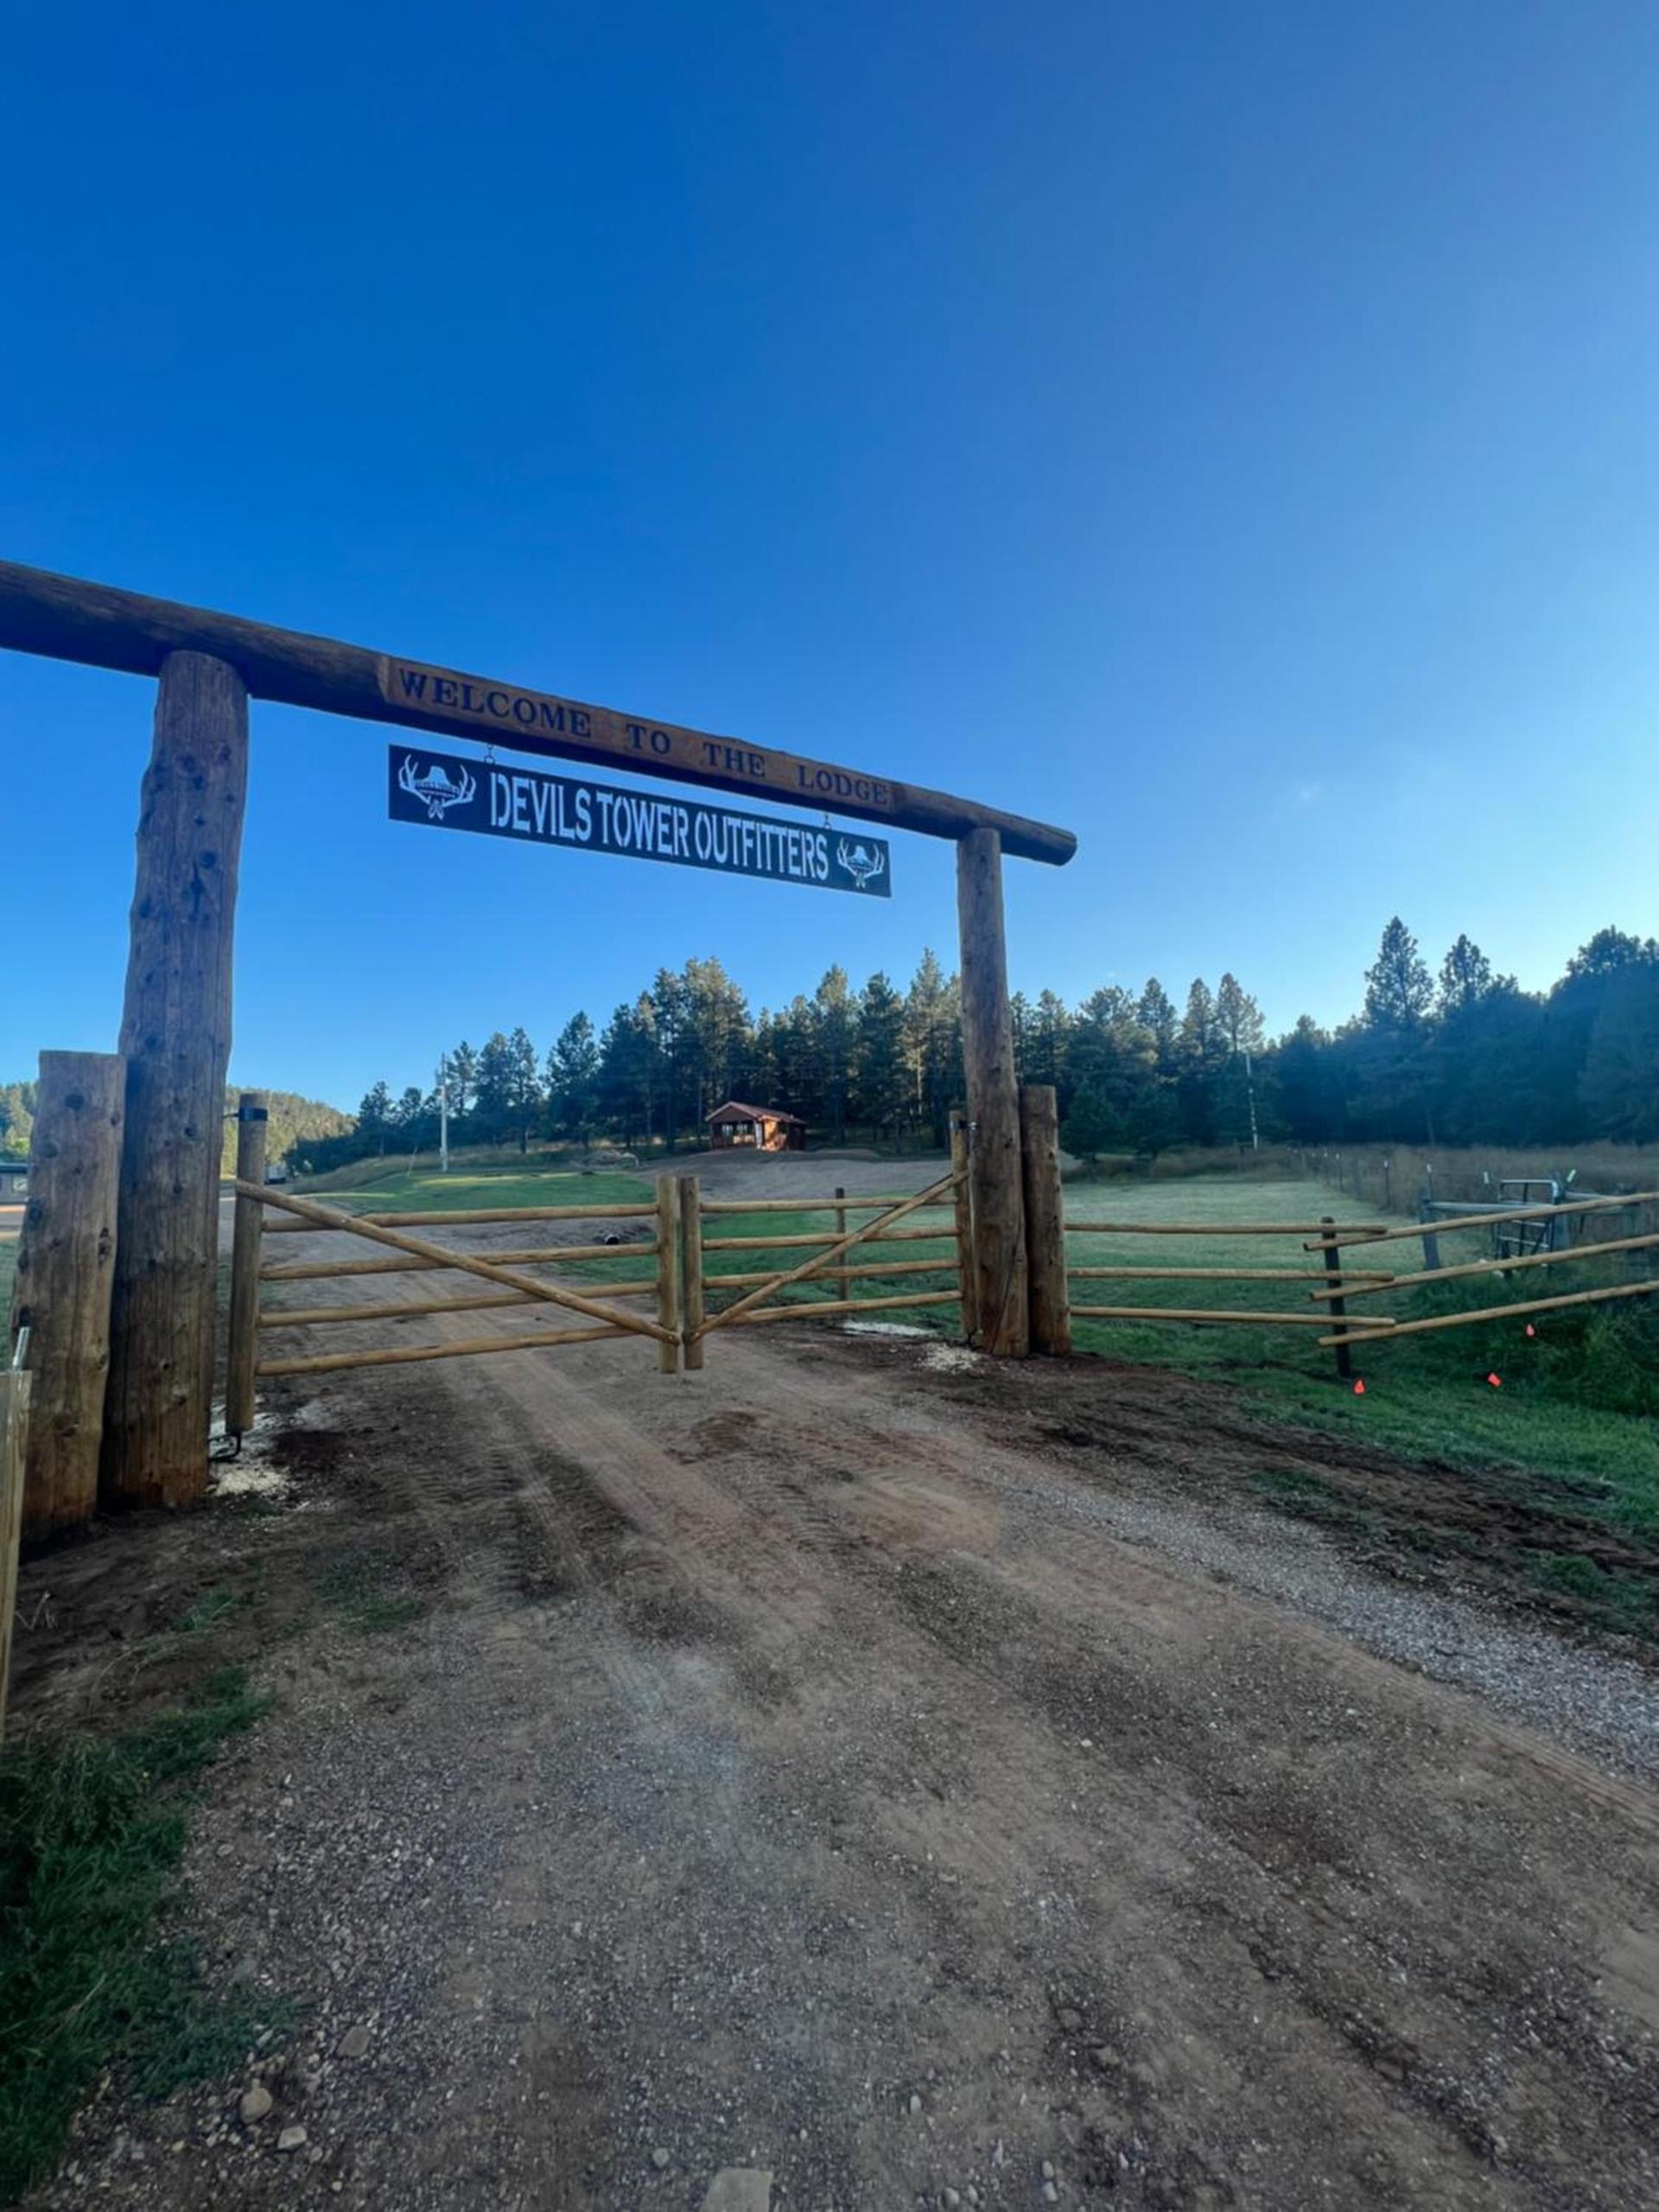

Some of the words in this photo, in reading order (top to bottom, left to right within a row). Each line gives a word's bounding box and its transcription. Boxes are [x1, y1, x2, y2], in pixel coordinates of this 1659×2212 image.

[399, 668, 591, 738] WELCOME
[626, 723, 671, 754] TO
[702, 742, 766, 778] THE
[798, 765, 887, 805] LODGE
[490, 772, 592, 842] DEVILS
[596, 791, 690, 857] TOWER
[695, 811, 829, 880] OUTFITTERS
